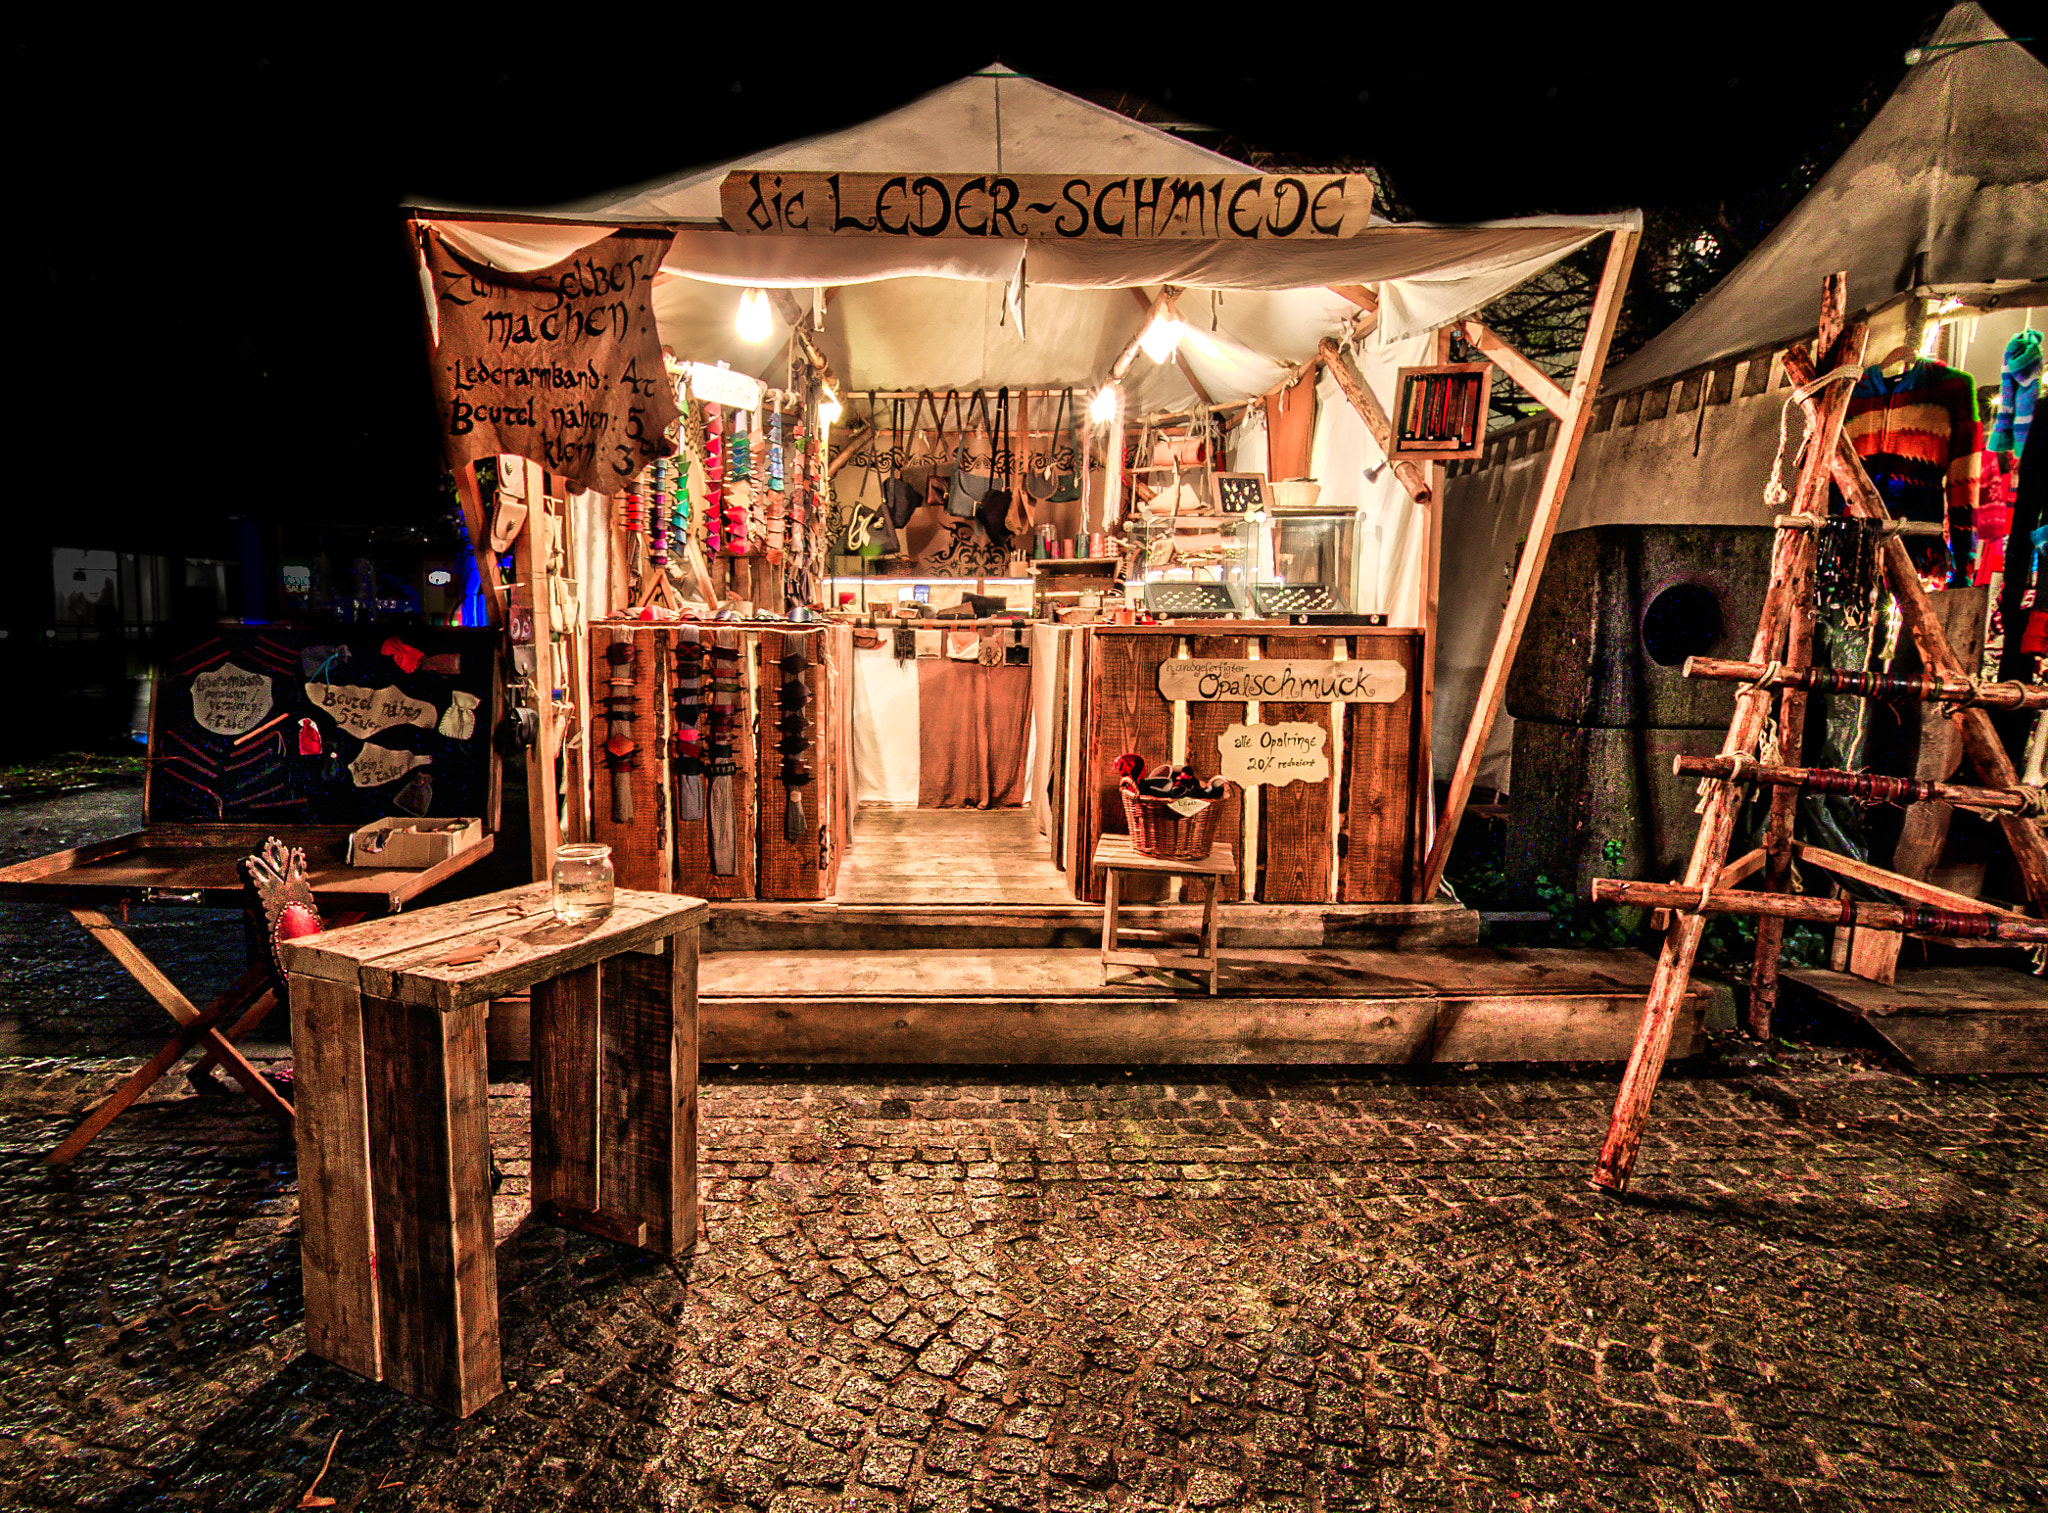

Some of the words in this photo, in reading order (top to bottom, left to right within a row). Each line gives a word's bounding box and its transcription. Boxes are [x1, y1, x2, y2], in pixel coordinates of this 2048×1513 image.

[746, 173, 809, 233] die
[482, 301, 648, 351] machen:
[449, 396, 537, 436] Beutel
[625, 406, 646, 440] 5
[612, 444, 634, 476] 3
[322, 684, 375, 710] Beutel
[382, 700, 422, 721] nähen
[338, 707, 351, 725] 5
[1234, 734, 1253, 749] alle
[1260, 731, 1317, 755] Opalringe
[361, 771, 372, 785] 3
[1246, 756, 1276, 773] 20%
